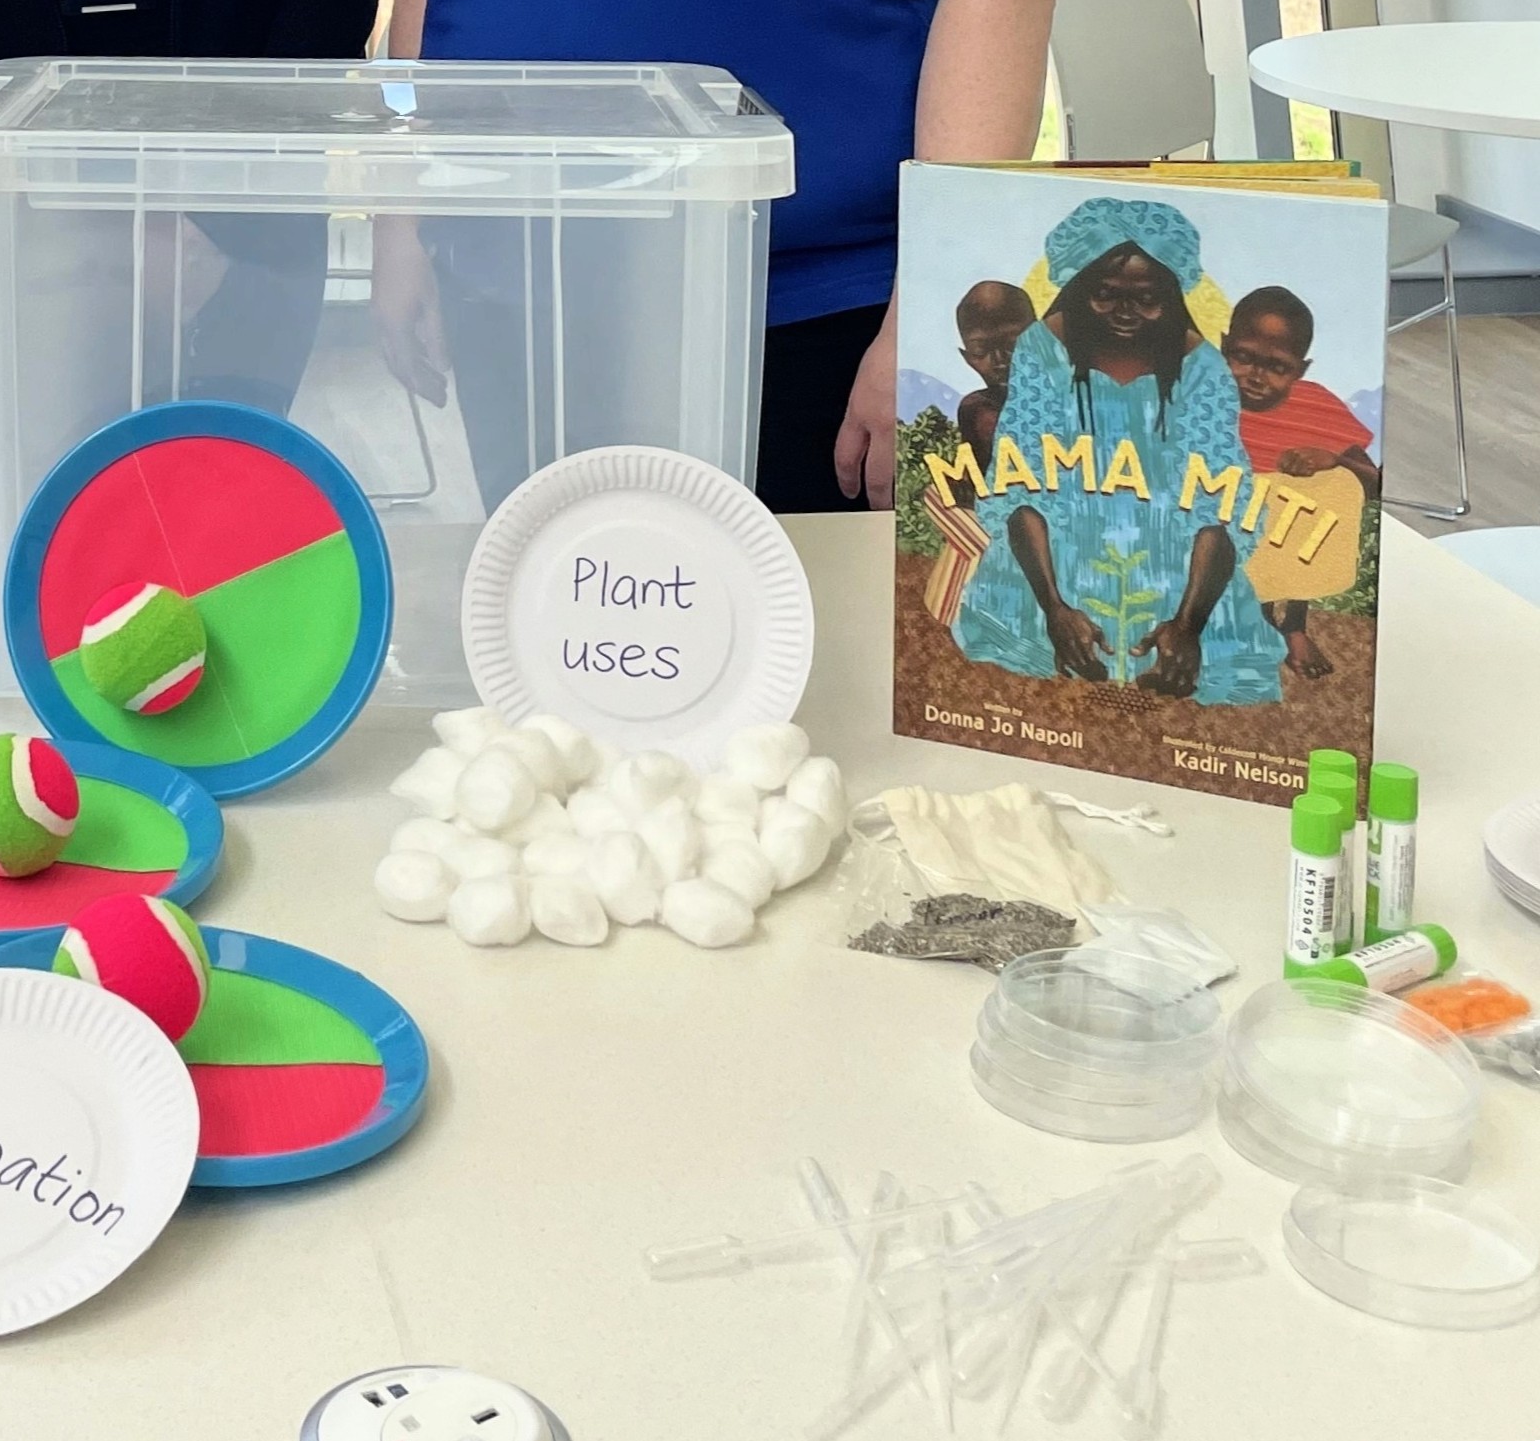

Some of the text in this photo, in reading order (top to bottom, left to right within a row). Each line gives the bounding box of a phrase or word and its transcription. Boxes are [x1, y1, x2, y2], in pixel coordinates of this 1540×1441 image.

[923, 433, 1339, 564] MAMA MITI
[573, 556, 697, 610] Plant
[563, 638, 681, 680] uses
[925, 704, 1084, 749] Donna Jo Napoli
[1174, 749, 1304, 789] Kadir Nelson
[1302, 867, 1317, 935] KF10504
